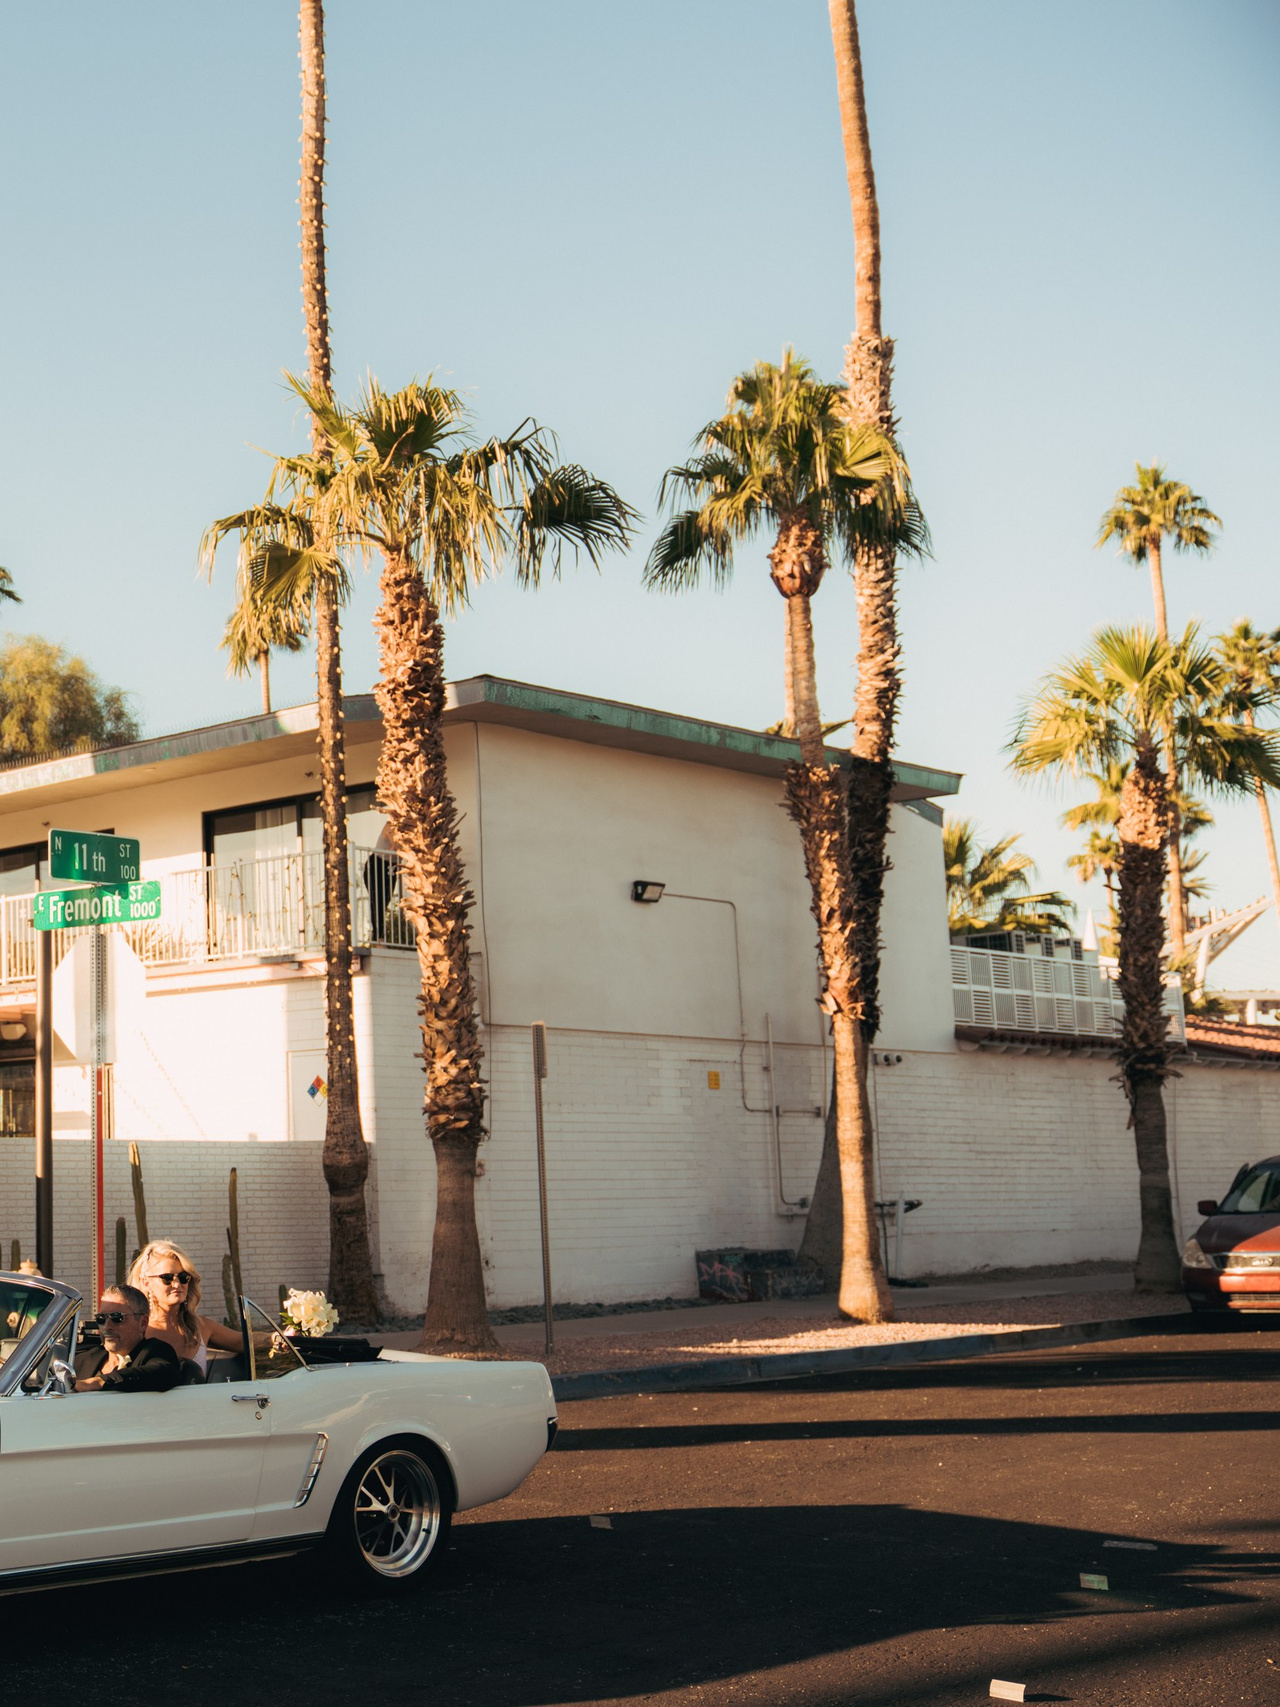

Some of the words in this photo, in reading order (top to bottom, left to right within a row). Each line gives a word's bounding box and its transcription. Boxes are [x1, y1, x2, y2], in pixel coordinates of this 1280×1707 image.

[55, 837, 62, 851] N
[119, 843, 131, 858] ST
[120, 865, 136, 880] 100
[38, 896, 44, 911] E
[49, 890, 121, 923] Fremont
[129, 885, 143, 901] ST
[129, 901, 156, 918] 1000
